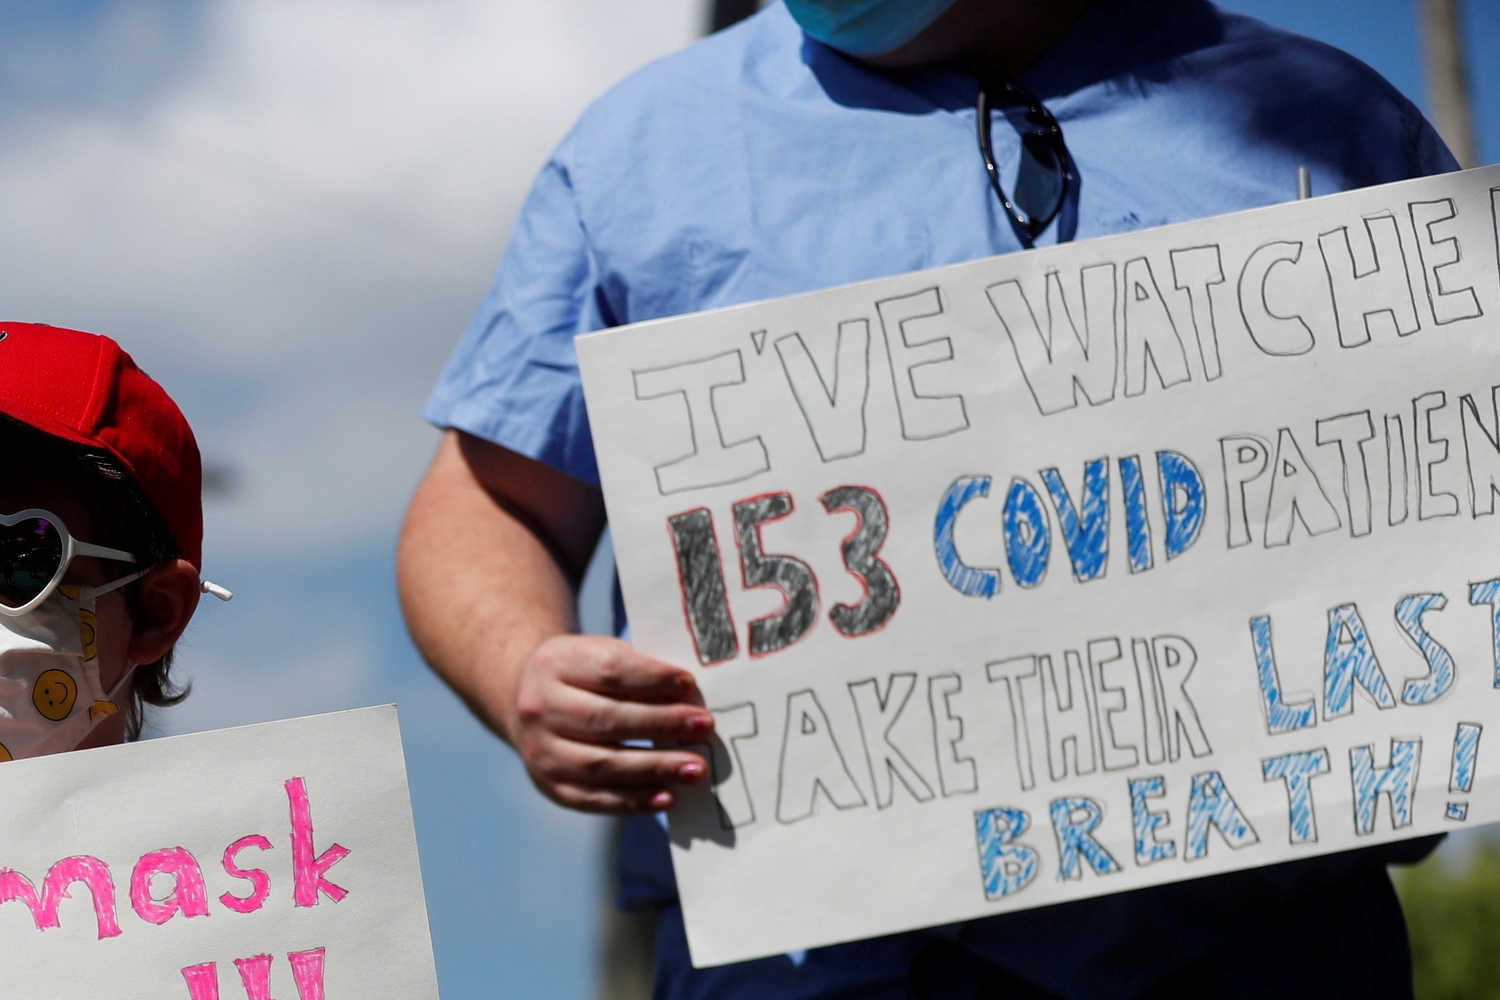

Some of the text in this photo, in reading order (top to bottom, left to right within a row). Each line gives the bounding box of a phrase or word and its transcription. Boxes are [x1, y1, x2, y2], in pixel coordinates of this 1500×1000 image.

[630, 186, 1500, 495] I'VE WATCHE
[667, 485, 901, 666] 153
[933, 450, 1206, 599] COVID
[690, 673, 978, 830] TAKE
[986, 635, 1213, 791] THEIR
[974, 721, 1483, 901] BREATH!
